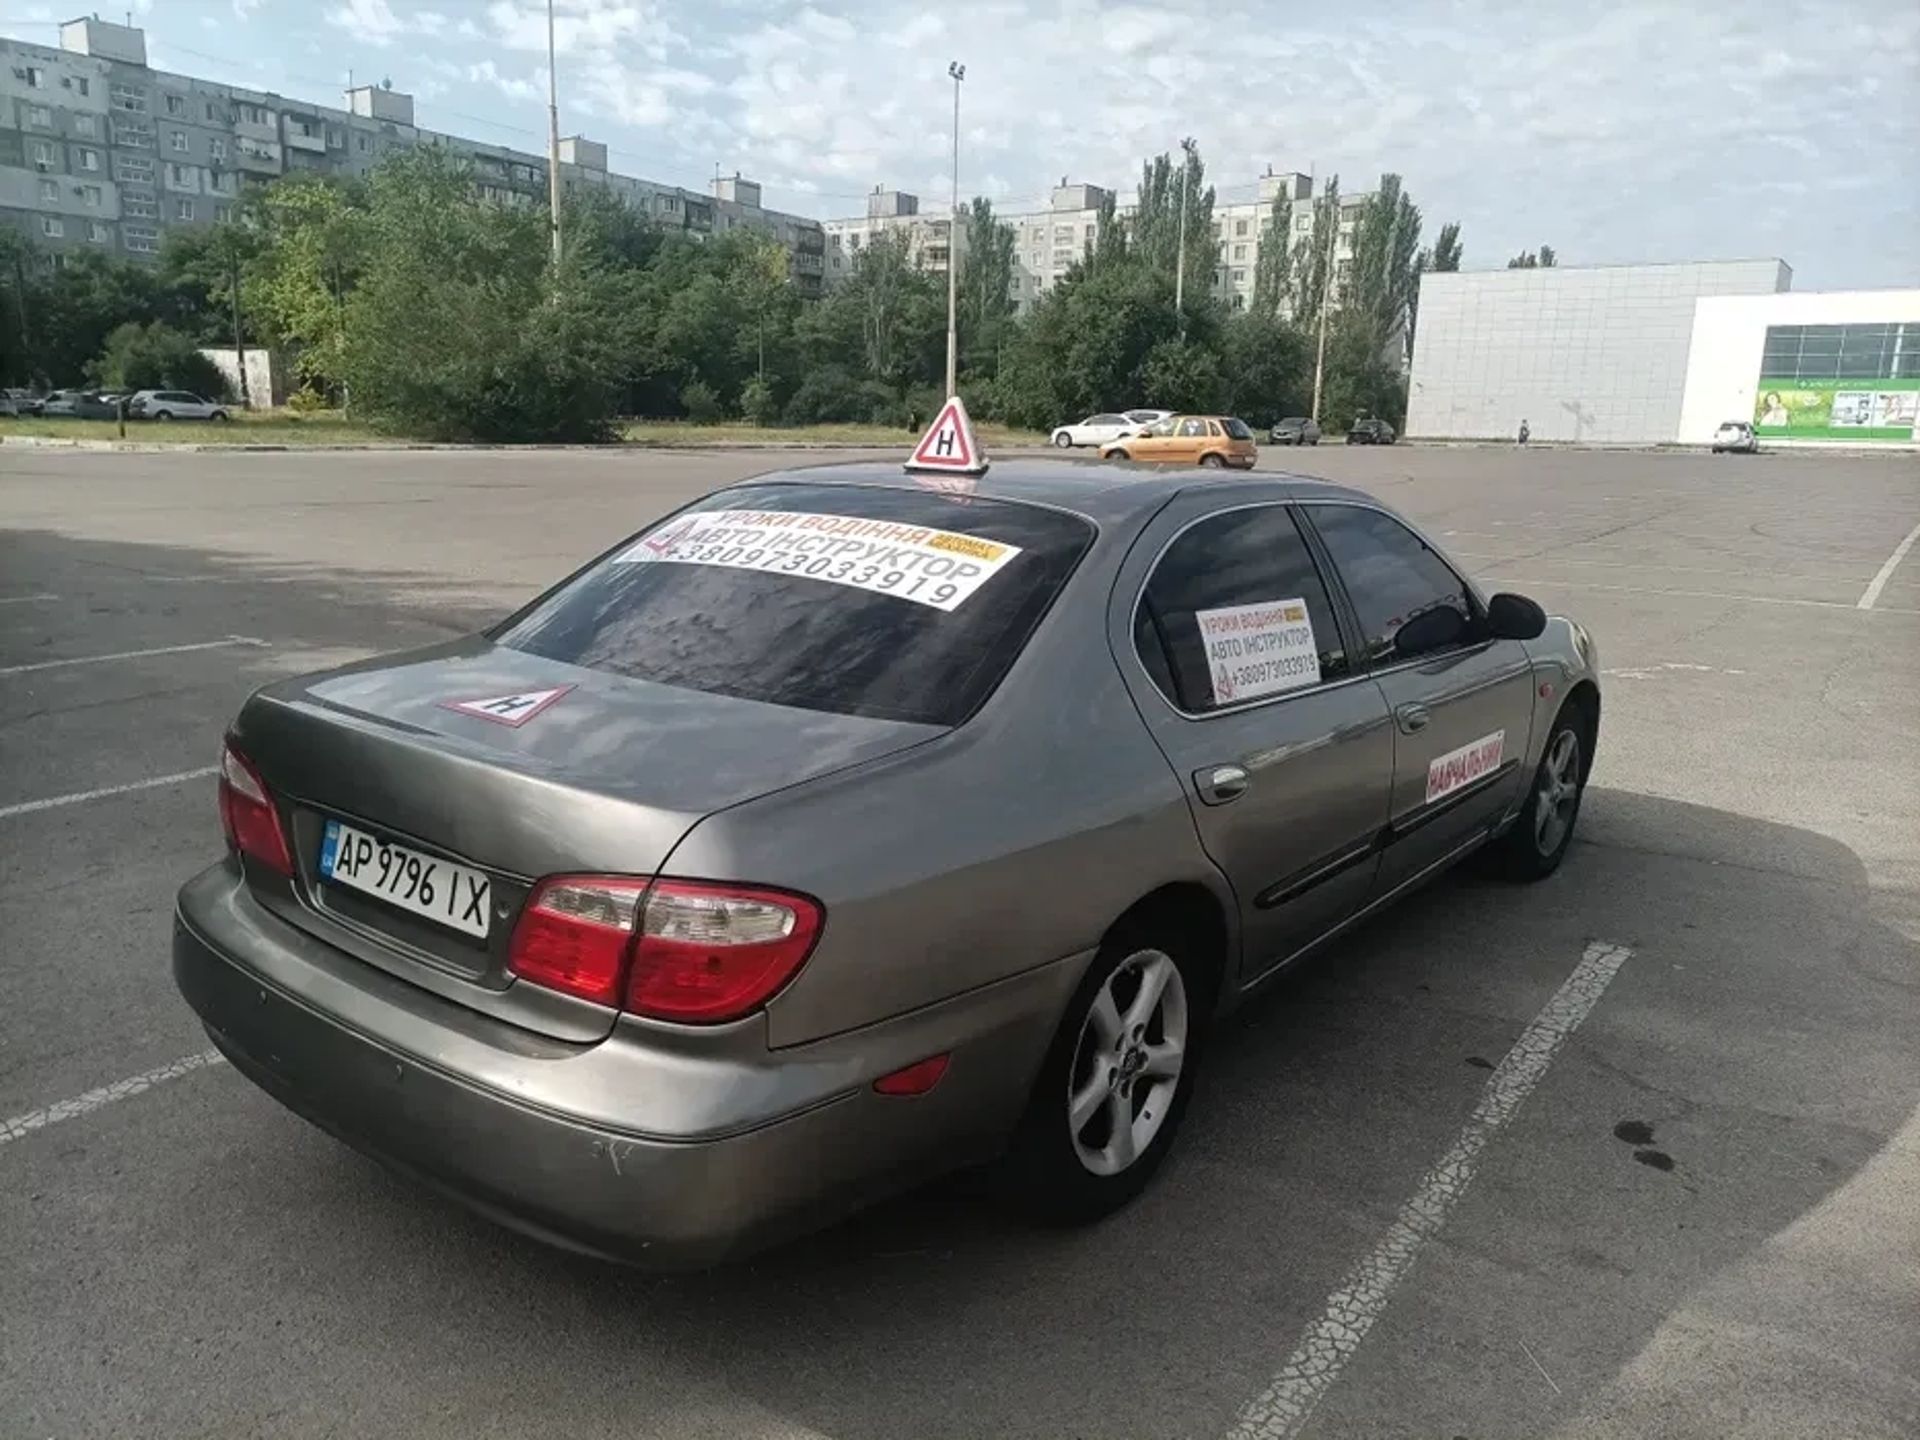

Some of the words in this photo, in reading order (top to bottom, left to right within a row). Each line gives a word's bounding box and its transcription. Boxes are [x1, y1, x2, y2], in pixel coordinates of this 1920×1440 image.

[717, 511, 796, 527] УРОКИ
[799, 515, 932, 544] ВОДІННЯ
[666, 545, 958, 603] +380973033919
[687, 528, 765, 545] АВТО
[762, 531, 982, 580] ІНСТРУКТОР
[1210, 638, 1242, 661] АВТО
[1244, 627, 1310, 655] ІНСТРУКТОР
[337, 832, 372, 877] AP
[376, 848, 436, 906] 9796
[448, 871, 489, 926] IX
